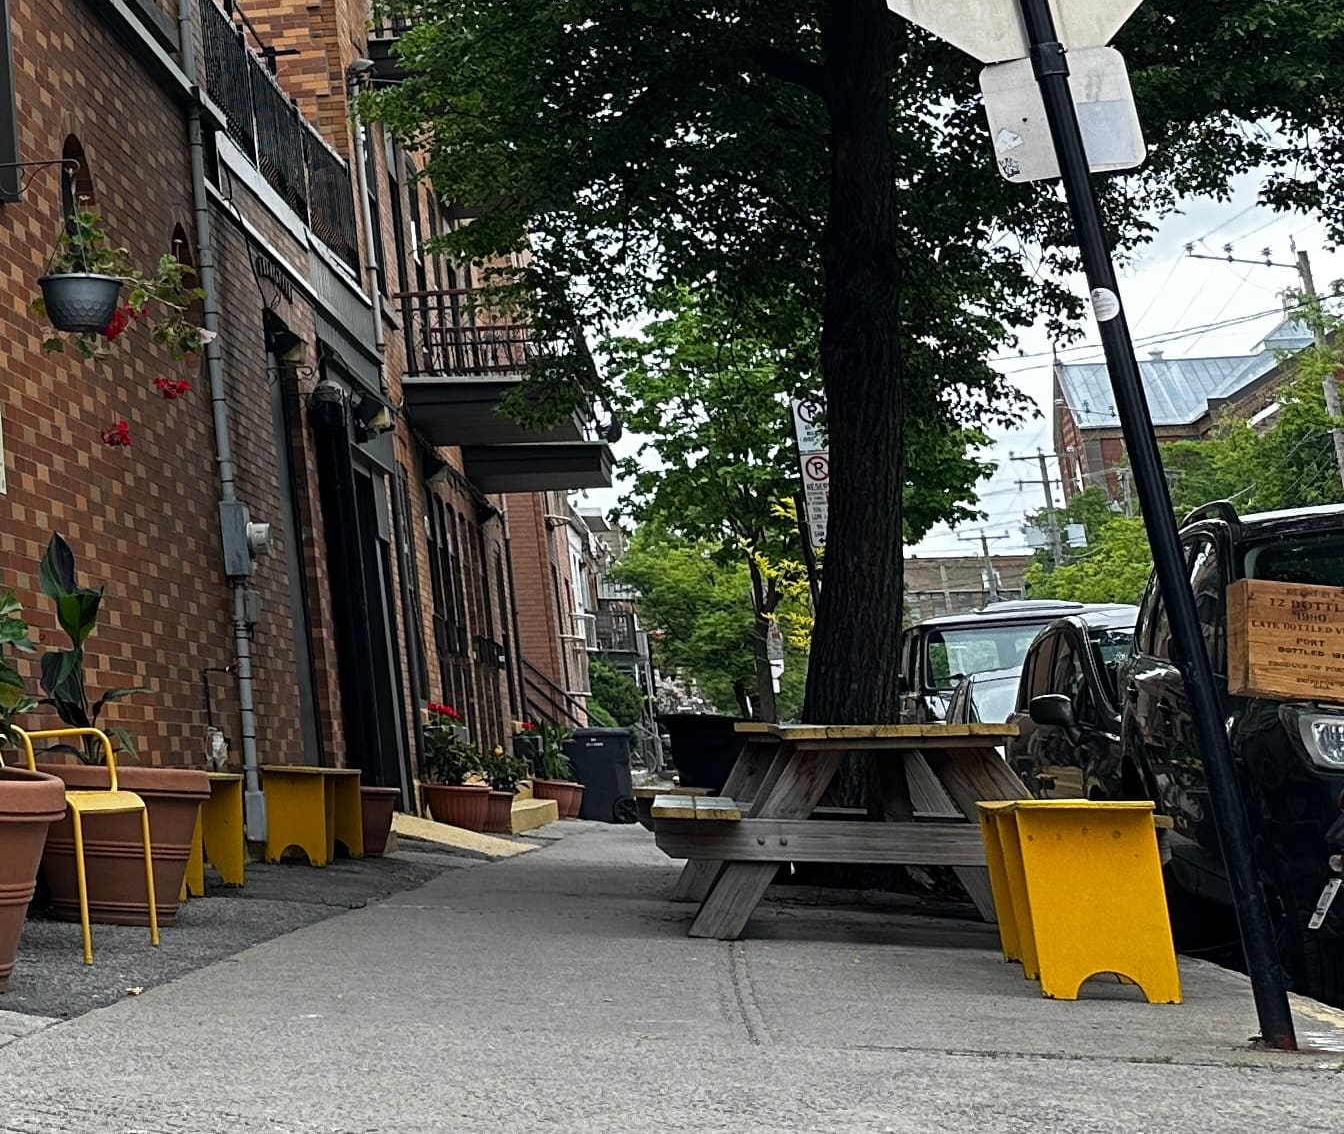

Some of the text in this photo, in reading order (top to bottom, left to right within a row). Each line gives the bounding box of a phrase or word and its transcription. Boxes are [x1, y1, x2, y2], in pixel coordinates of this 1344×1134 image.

[1270, 598, 1344, 612] 12 BOTTL
[1252, 620, 1280, 629] LATE
[1283, 623, 1332, 633] BOTTLED
[1296, 638, 1325, 646] PORT
[1278, 646, 1325, 657] BOTTLED
